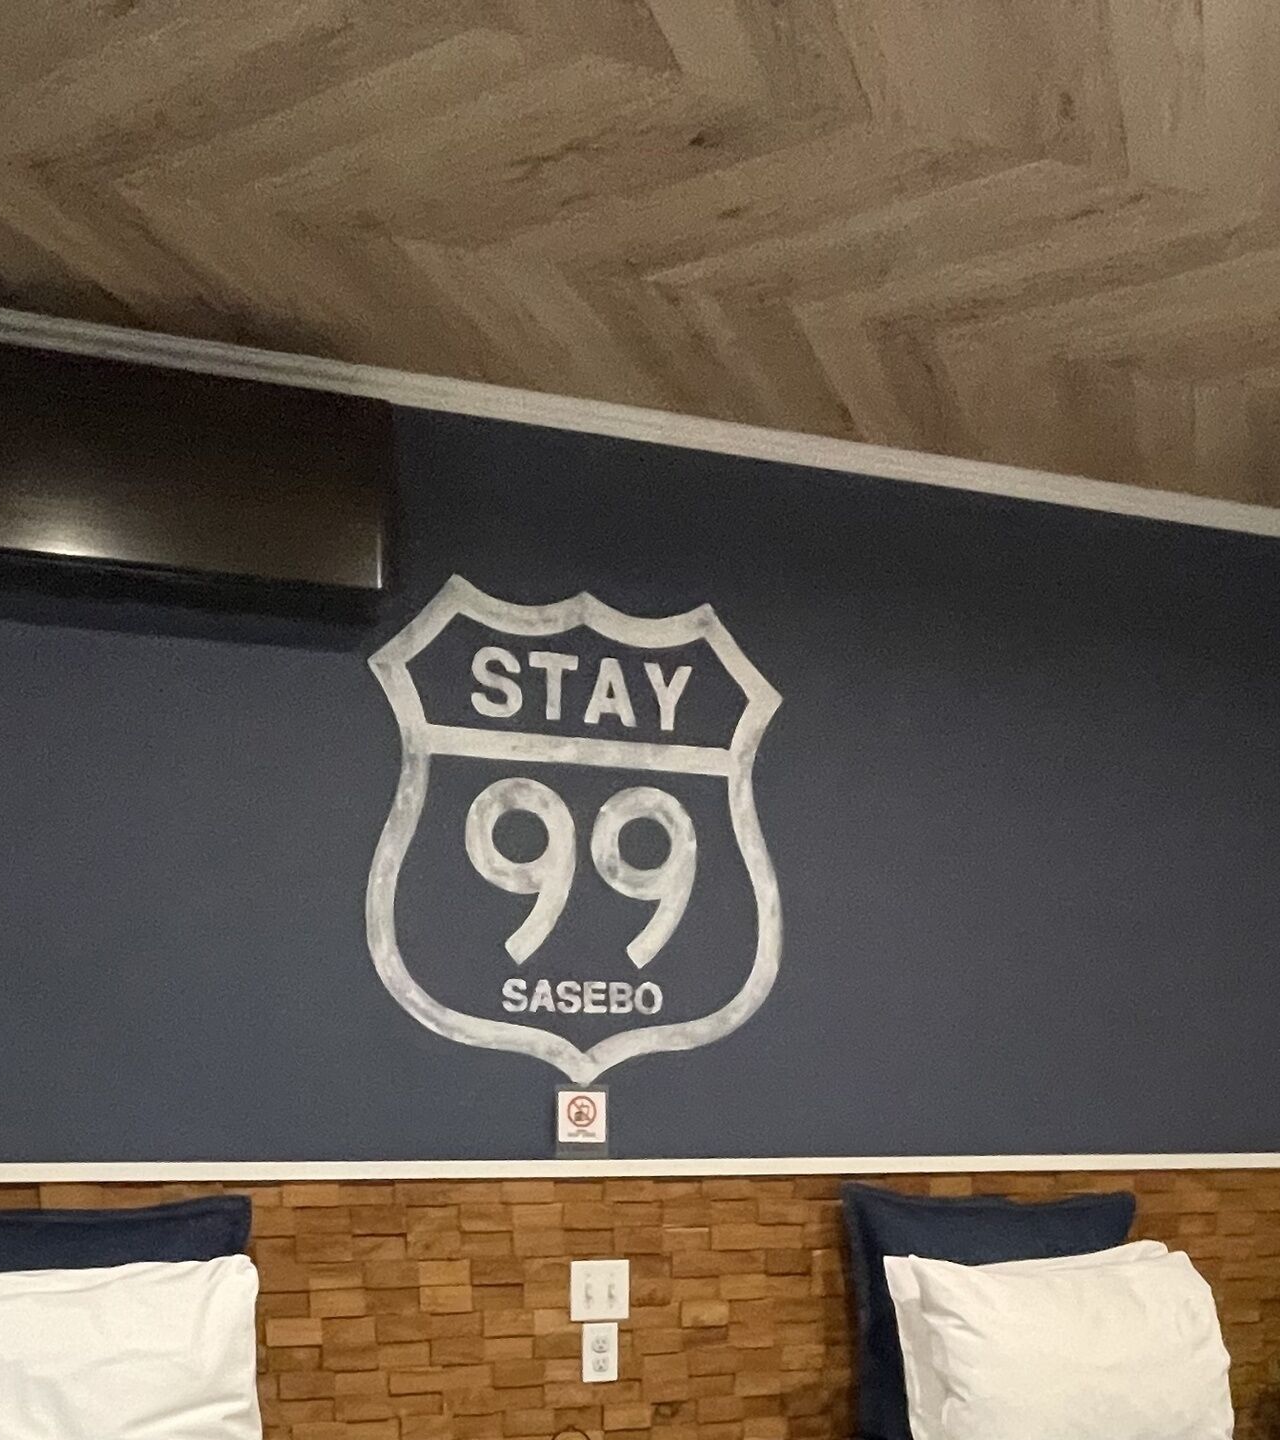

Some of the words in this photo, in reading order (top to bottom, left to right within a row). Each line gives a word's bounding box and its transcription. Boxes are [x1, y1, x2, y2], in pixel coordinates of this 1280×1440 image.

[470, 645, 693, 731] STAY
[464, 776, 698, 969] 99
[501, 978, 664, 1015] SASEBO
